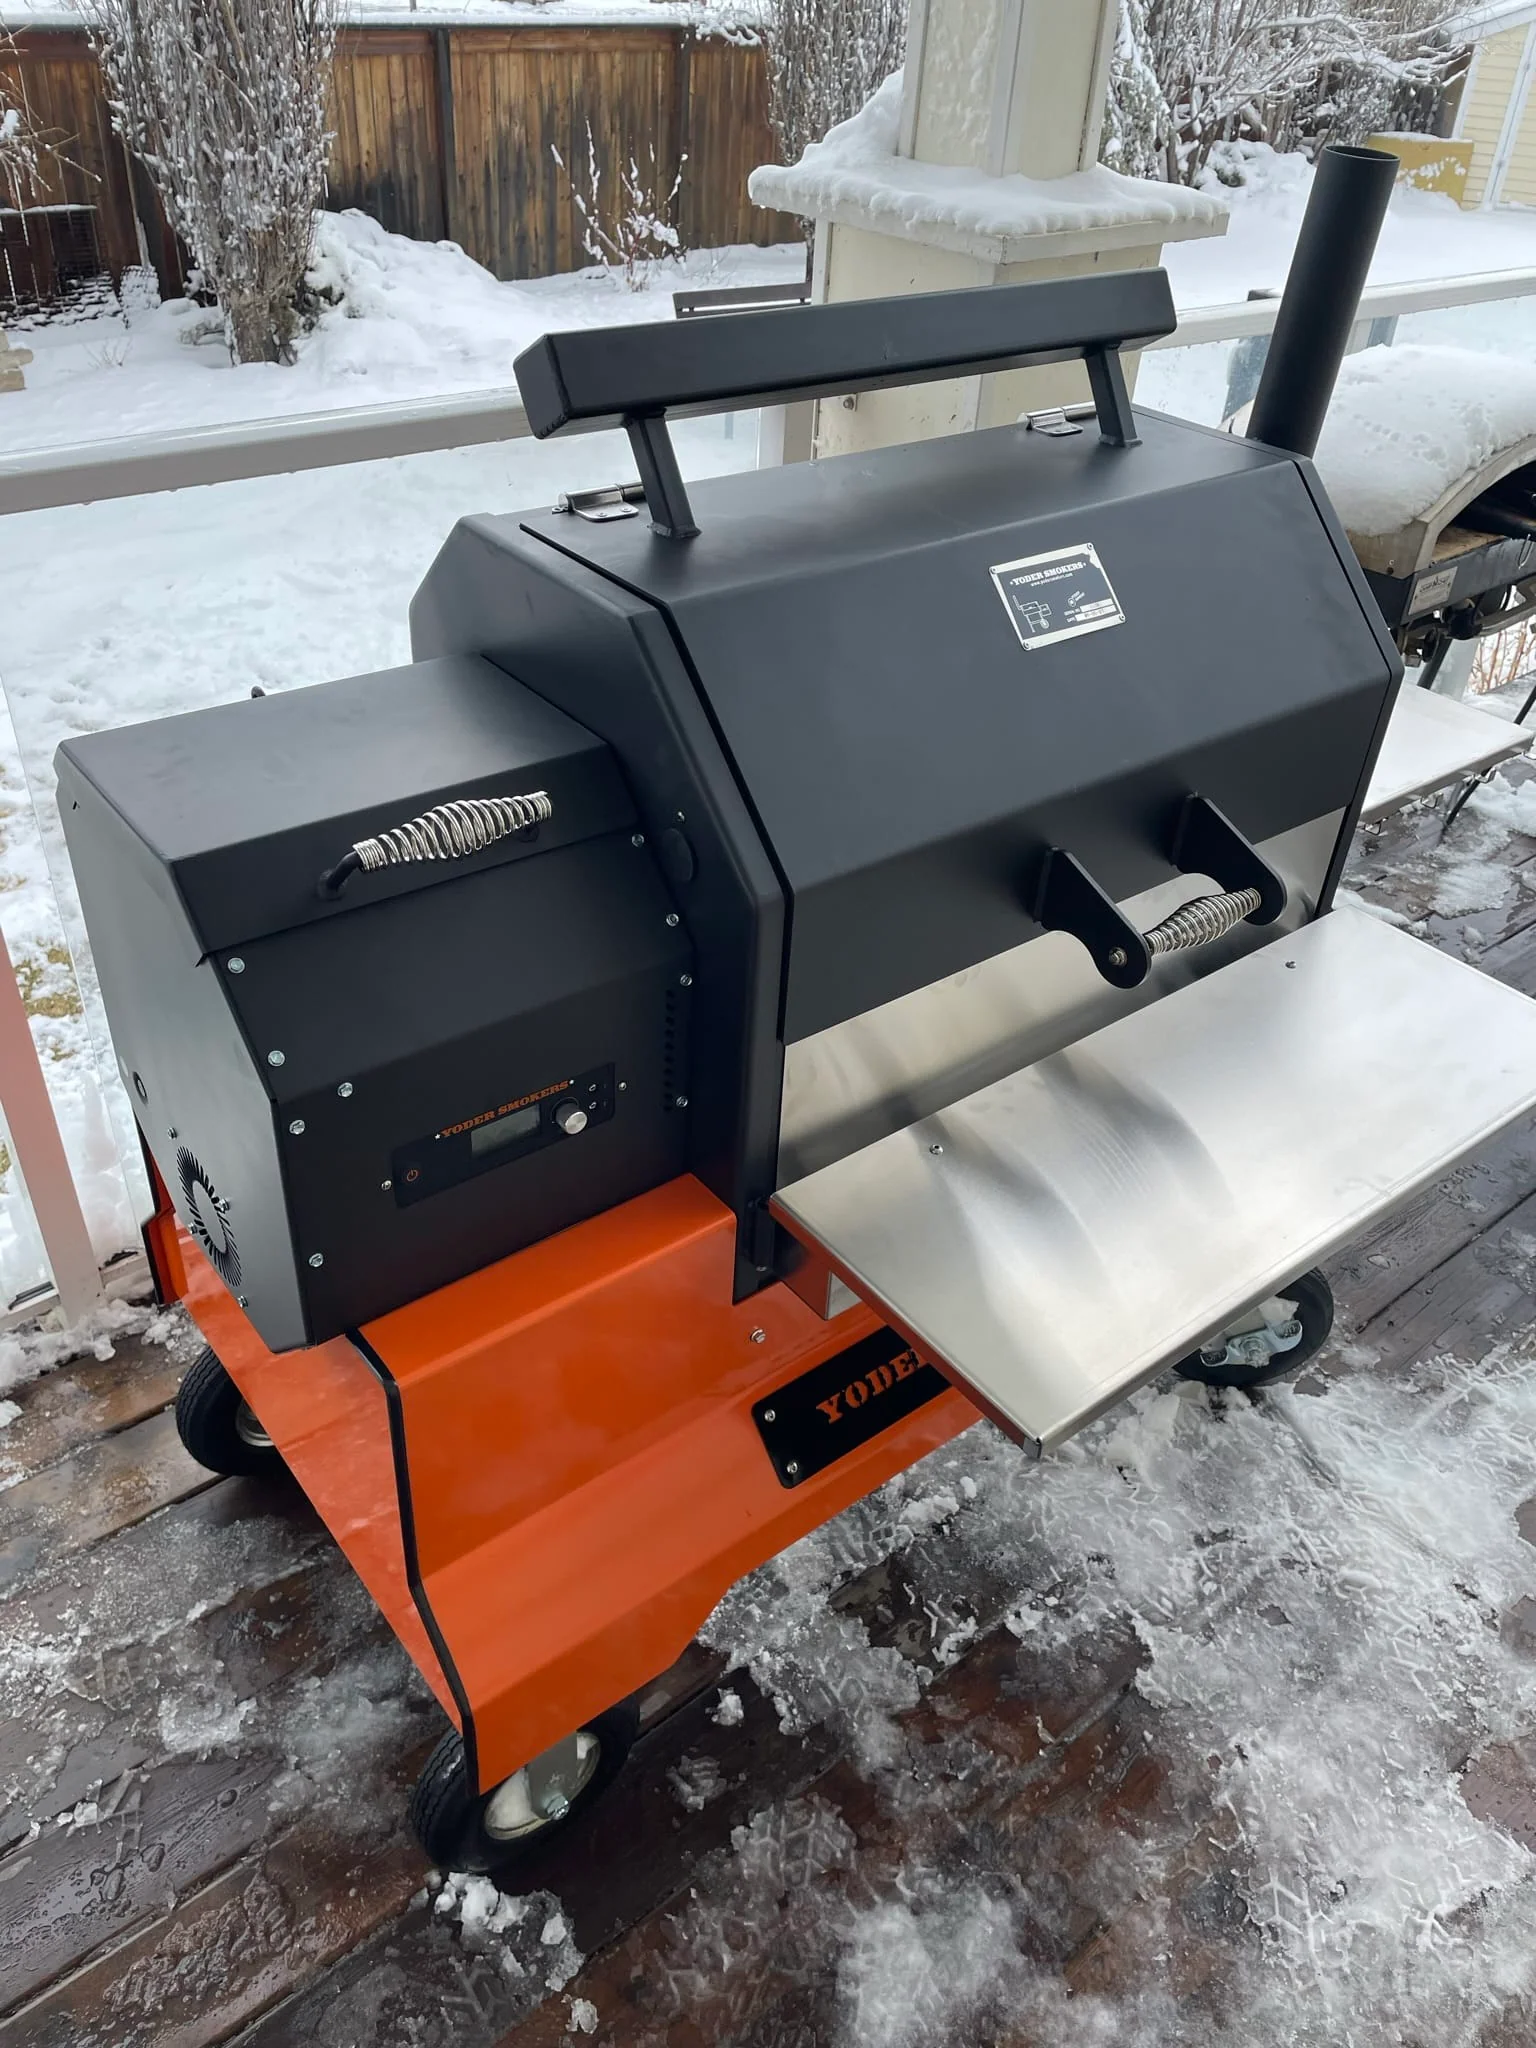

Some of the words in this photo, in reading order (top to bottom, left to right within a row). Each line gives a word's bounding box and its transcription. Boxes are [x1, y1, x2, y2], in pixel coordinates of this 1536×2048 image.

[1012, 572, 1044, 586] YODER
[1043, 561, 1084, 578] SMOKERS
[441, 1110, 496, 1137] YODER
[498, 1080, 569, 1116] SMOKERS
[815, 1349, 928, 1425] YODE
